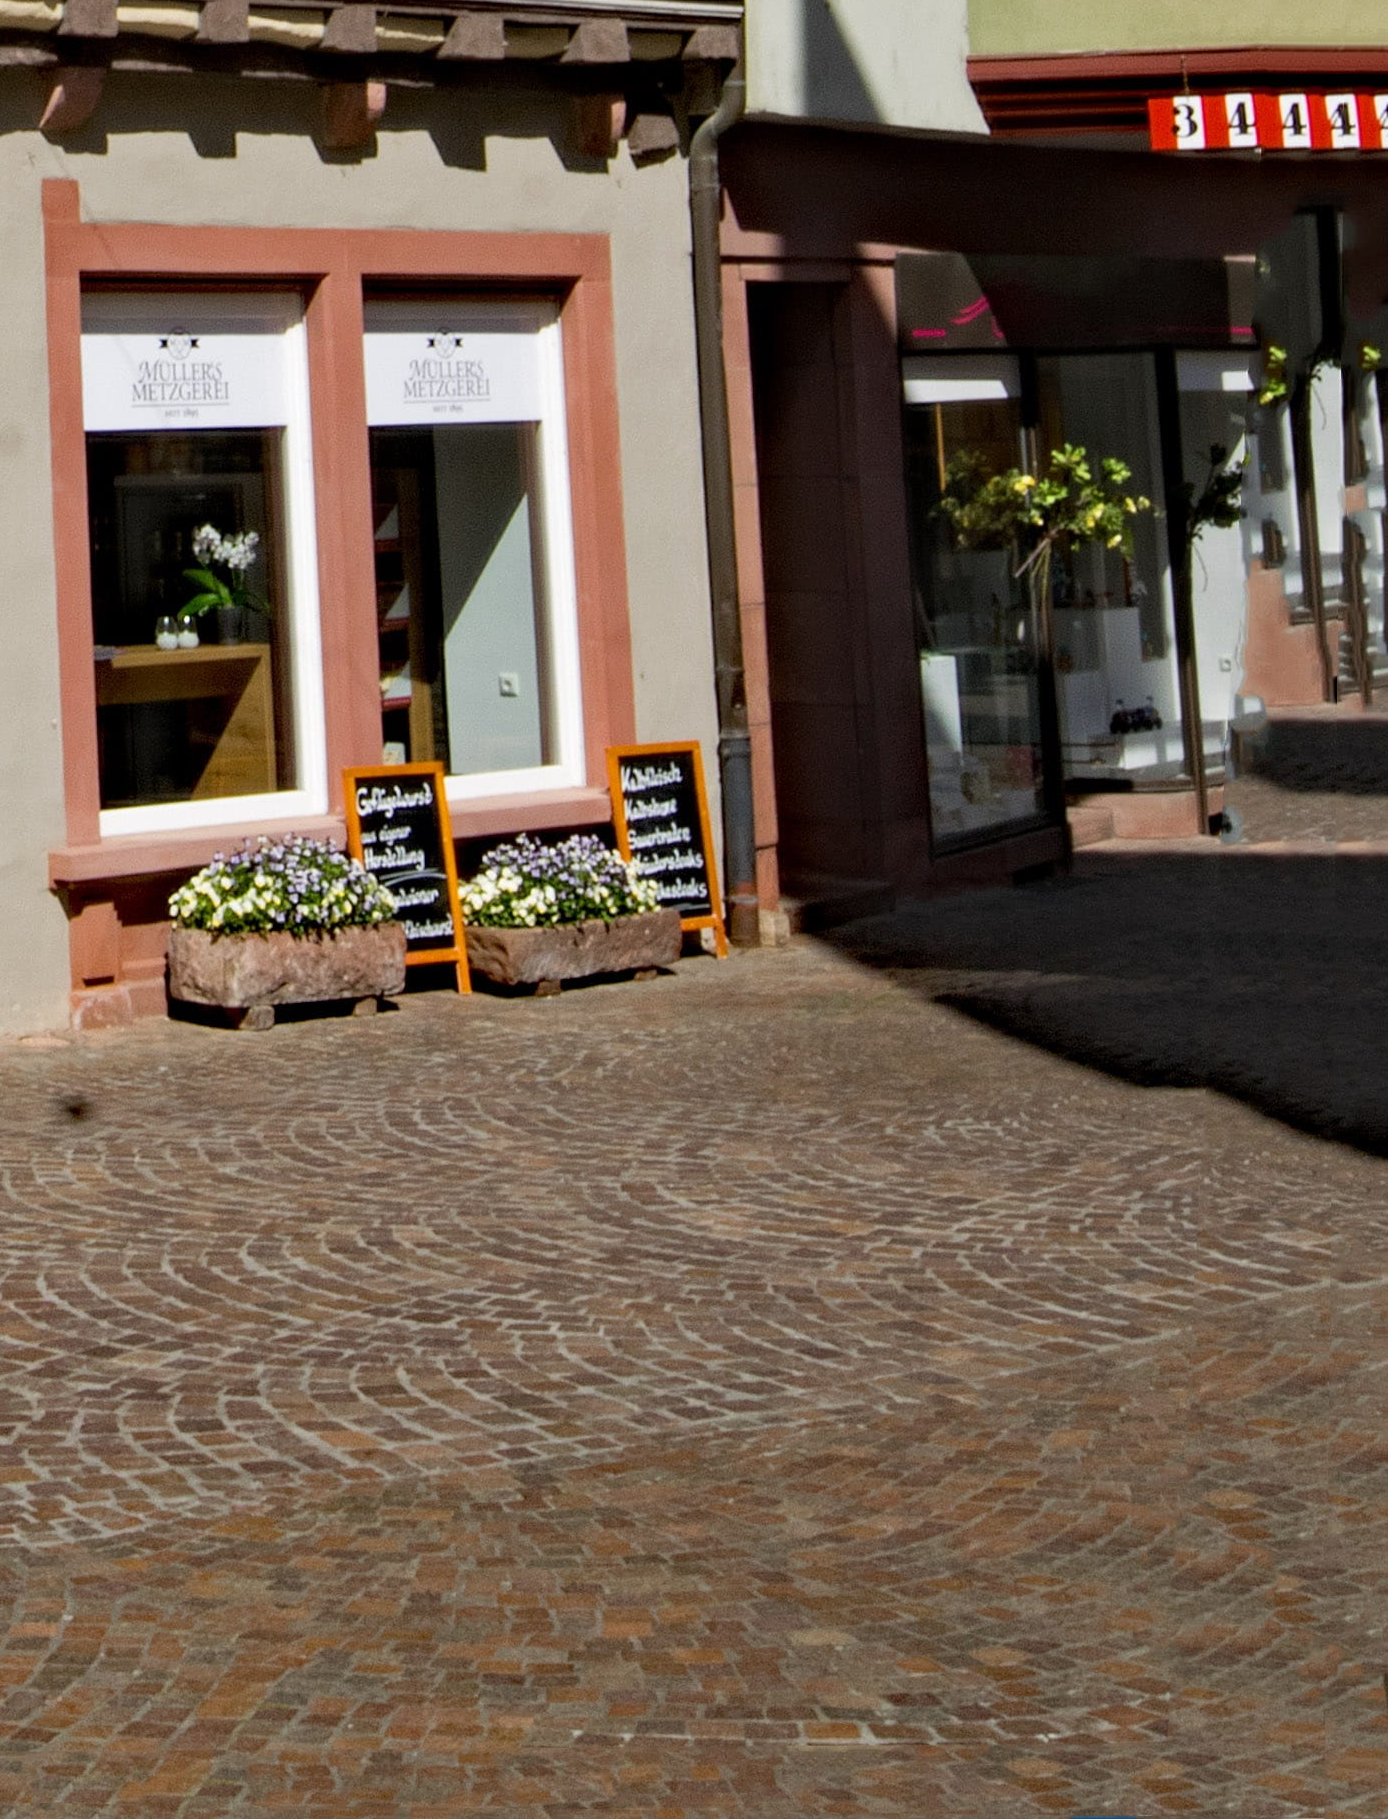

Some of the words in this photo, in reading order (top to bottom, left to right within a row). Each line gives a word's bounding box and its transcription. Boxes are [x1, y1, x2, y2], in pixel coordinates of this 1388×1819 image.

[132, 381, 229, 402] METZGEREI
[403, 378, 490, 399] METZGEREI
[364, 845, 426, 872] Herstellung
